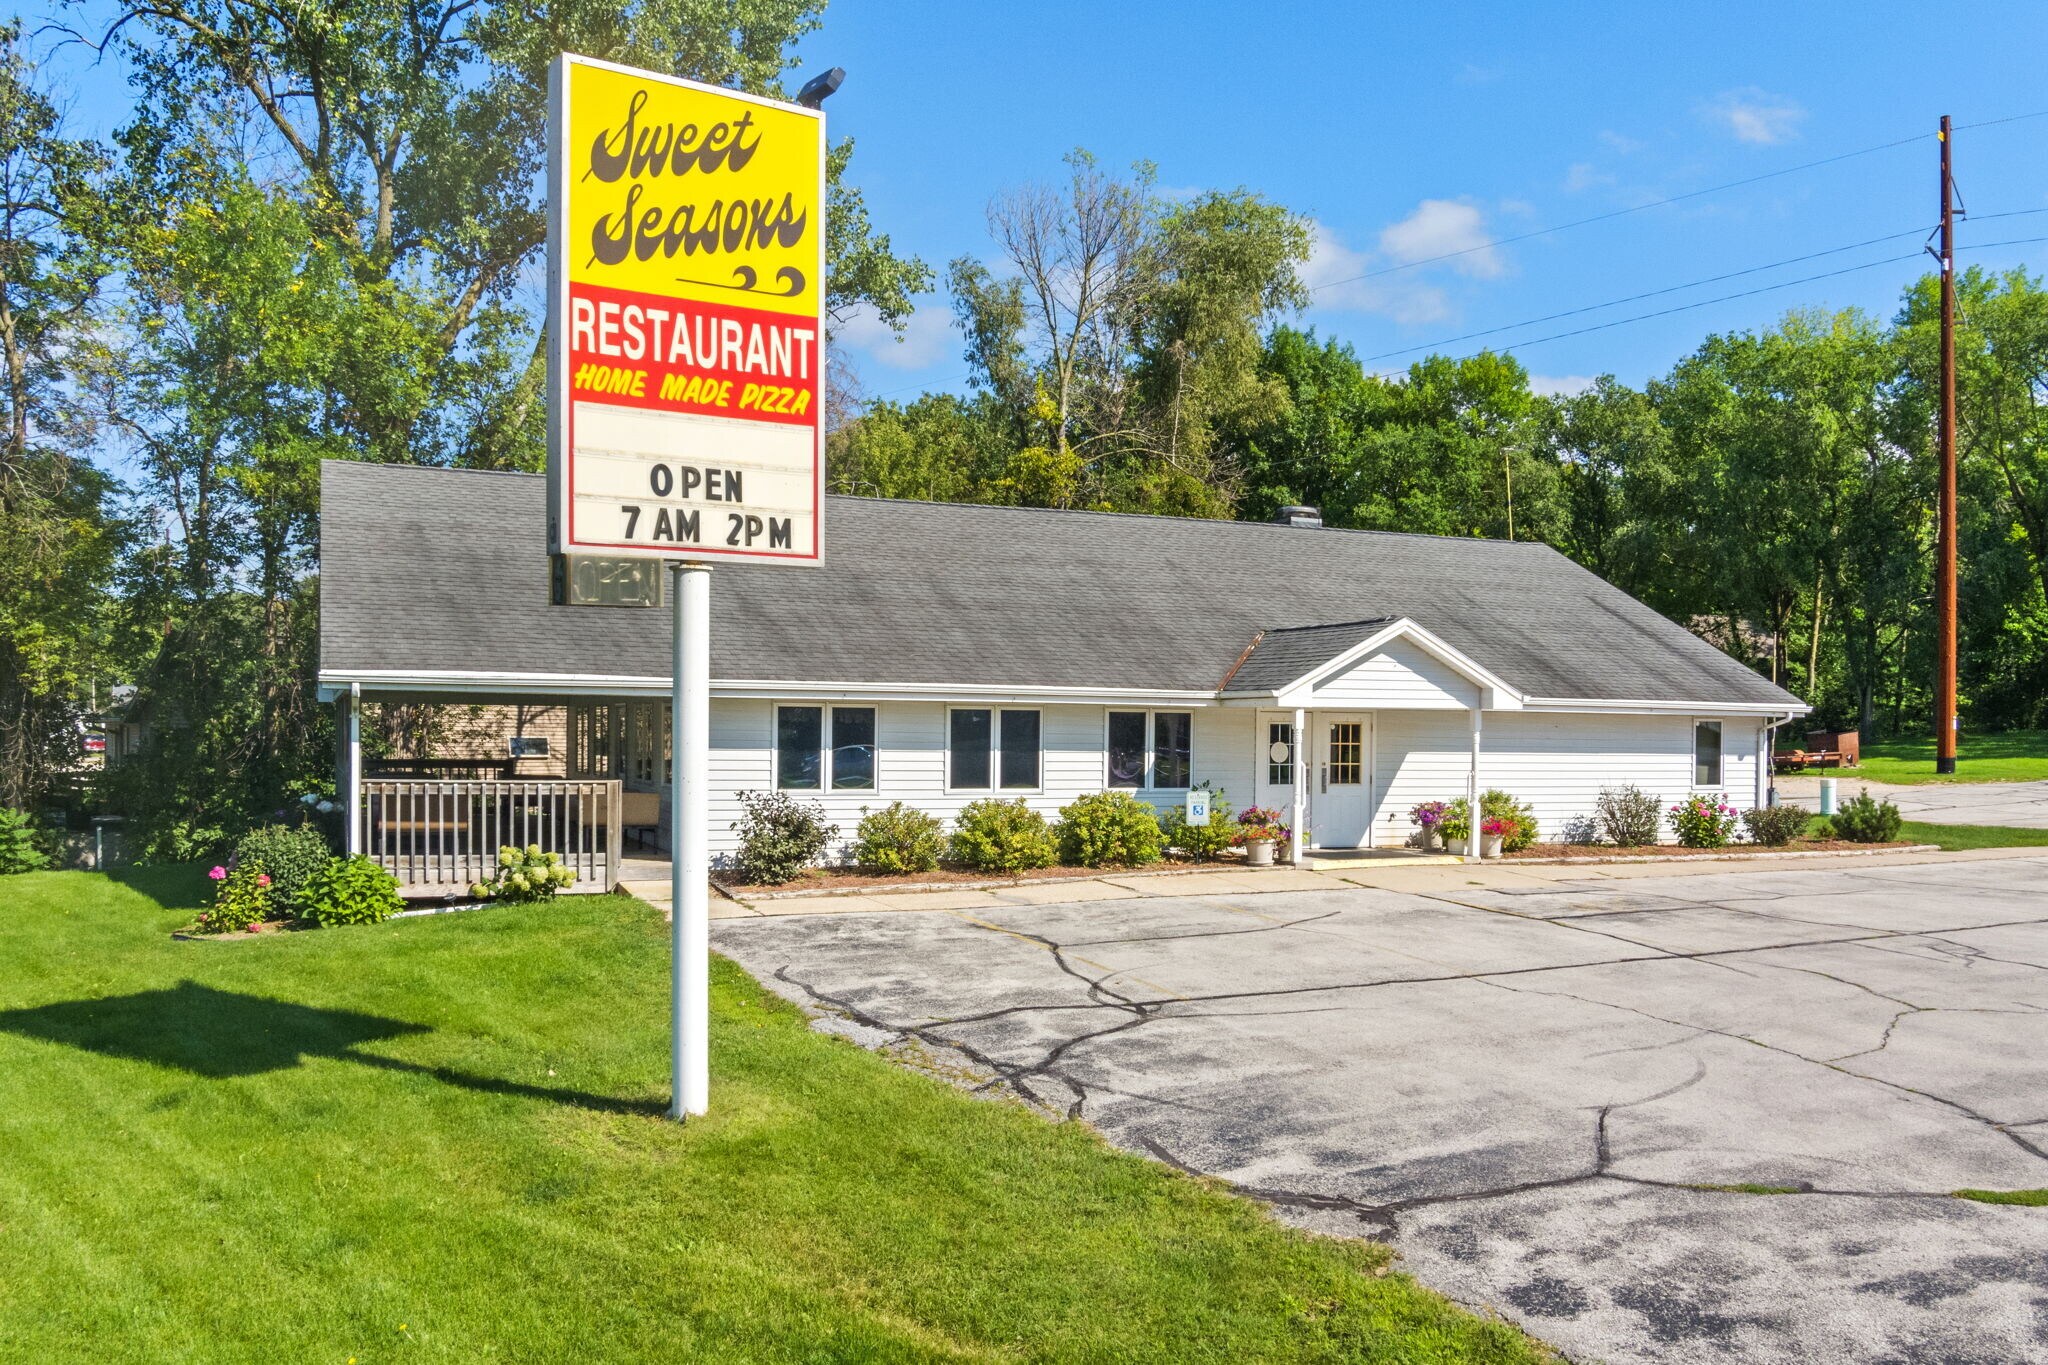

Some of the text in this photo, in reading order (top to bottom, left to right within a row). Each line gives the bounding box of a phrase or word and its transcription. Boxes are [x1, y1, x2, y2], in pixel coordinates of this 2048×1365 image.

[582, 90, 762, 183] Sweet
[586, 184, 807, 269] Seasons
[572, 297, 814, 379] RESTAURANT
[574, 363, 811, 416] HOME MADE PIZZA
[650, 463, 743, 503] OPEN
[621, 505, 792, 549] 7 AM 2PM
